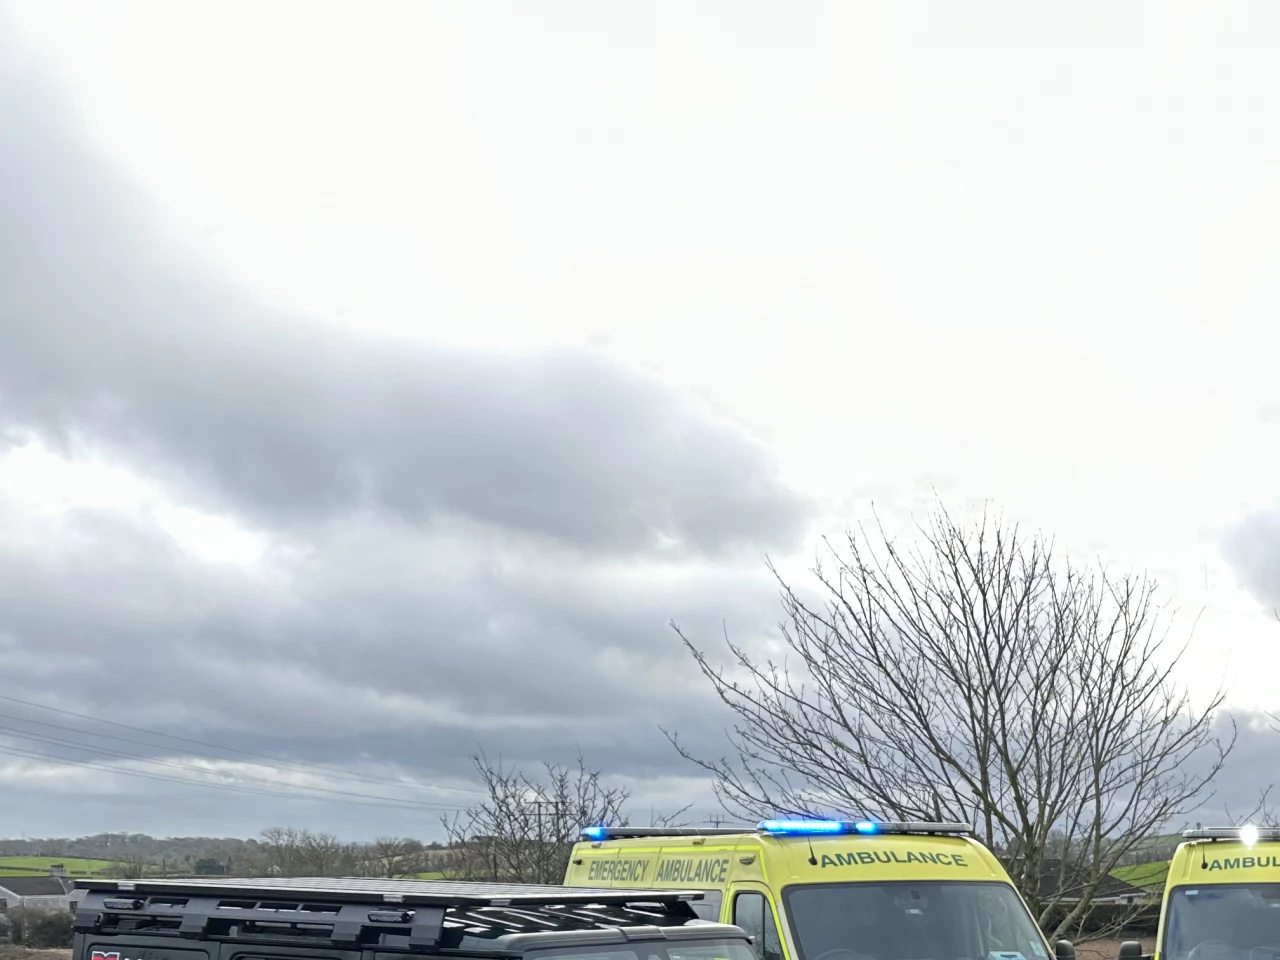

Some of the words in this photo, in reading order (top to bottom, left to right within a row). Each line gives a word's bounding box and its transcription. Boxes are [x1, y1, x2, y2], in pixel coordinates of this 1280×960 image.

[821, 851, 968, 868] AMBULANCE
[588, 860, 649, 881] EMERGENCY
[655, 859, 730, 883] AMBULANCE
